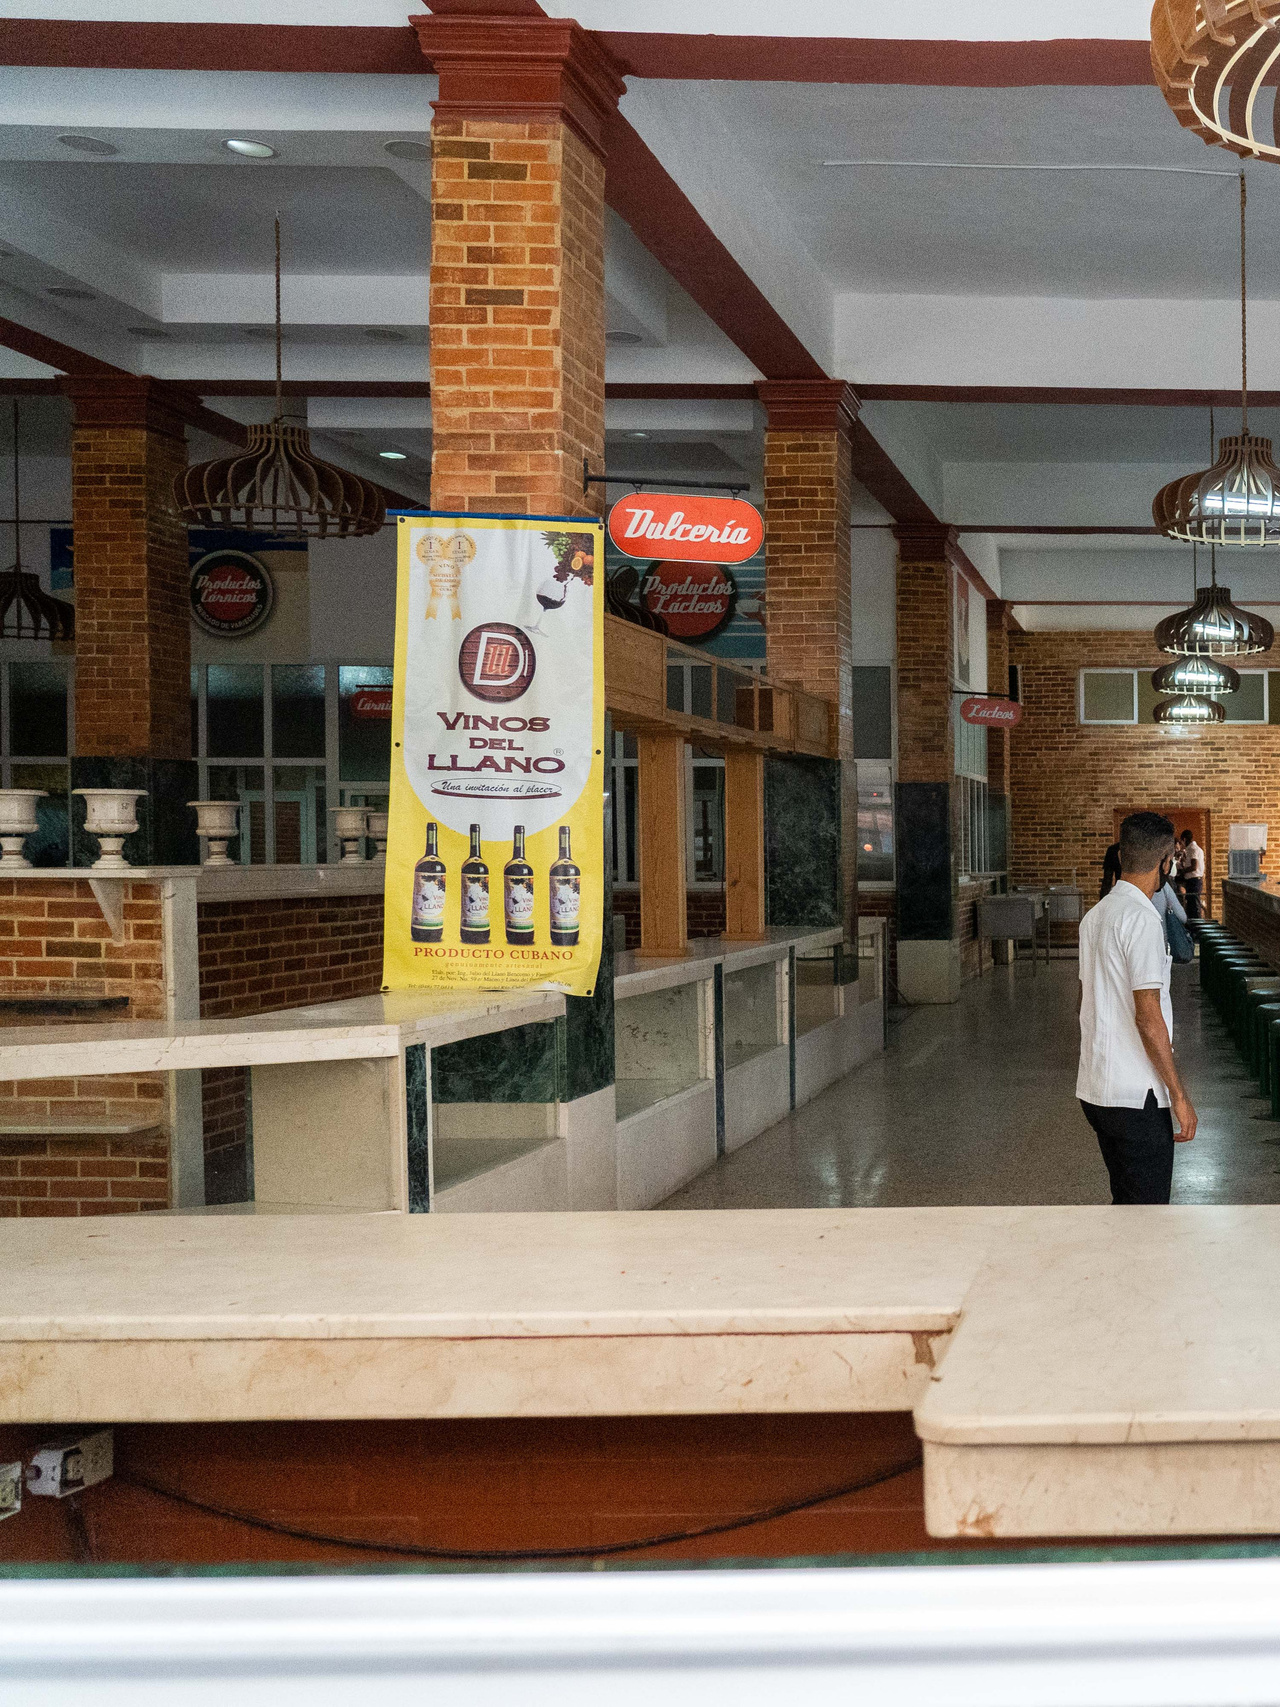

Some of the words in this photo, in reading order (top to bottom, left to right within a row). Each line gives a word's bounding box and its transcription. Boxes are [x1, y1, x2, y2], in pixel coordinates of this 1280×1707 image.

[624, 508, 751, 545] Dulcería
[195, 574, 263, 590] Productos
[642, 575, 736, 595] Productos
[200, 588, 259, 603] Cárnicos
[649, 594, 726, 614] Lácteos
[967, 704, 1016, 720] Lácteos
[436, 711, 551, 732] VINOS
[469, 737, 524, 751] DEL
[427, 754, 566, 774] LLANO
[441, 781, 462, 791] Una
[465, 783, 510, 793] invitación
[513, 784, 523, 793] al
[525, 785, 553, 795] placer
[414, 947, 504, 959] PRODUCTO
[509, 949, 574, 960] CUBANO
